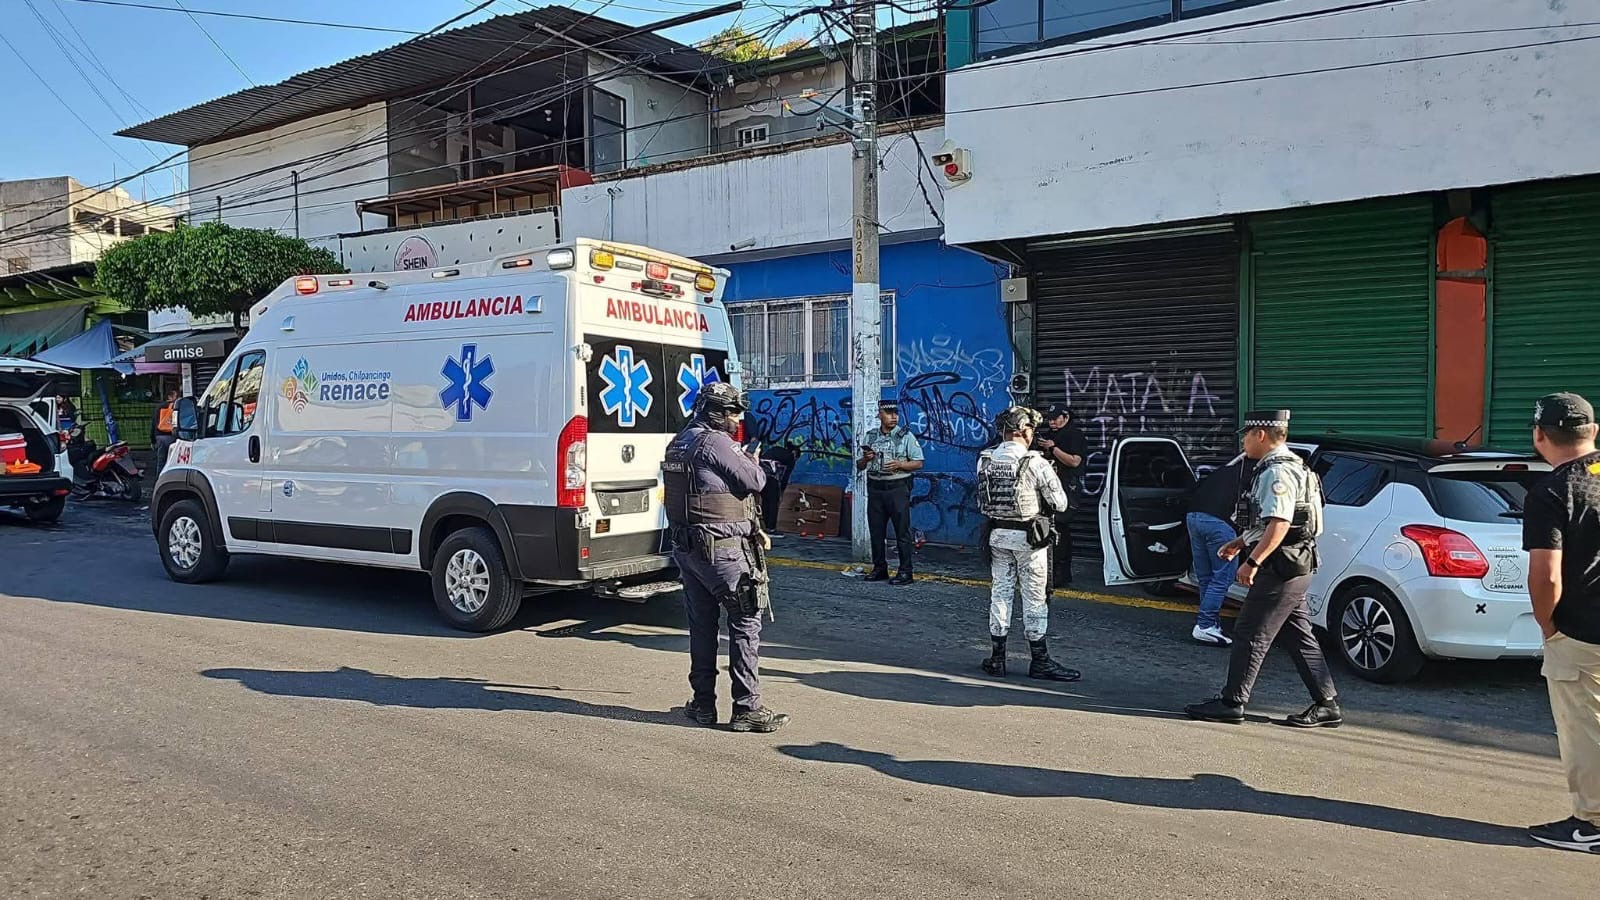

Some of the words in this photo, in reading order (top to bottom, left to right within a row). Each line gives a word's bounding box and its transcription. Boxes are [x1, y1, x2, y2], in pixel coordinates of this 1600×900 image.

[403, 256, 428, 270] SHEIN
[404, 295, 523, 322] AMBULANCIA
[606, 297, 709, 332] AMBULANCIA
[164, 344, 203, 359] amise
[320, 382, 390, 401] Renace
[660, 462, 682, 470] OLICIA
